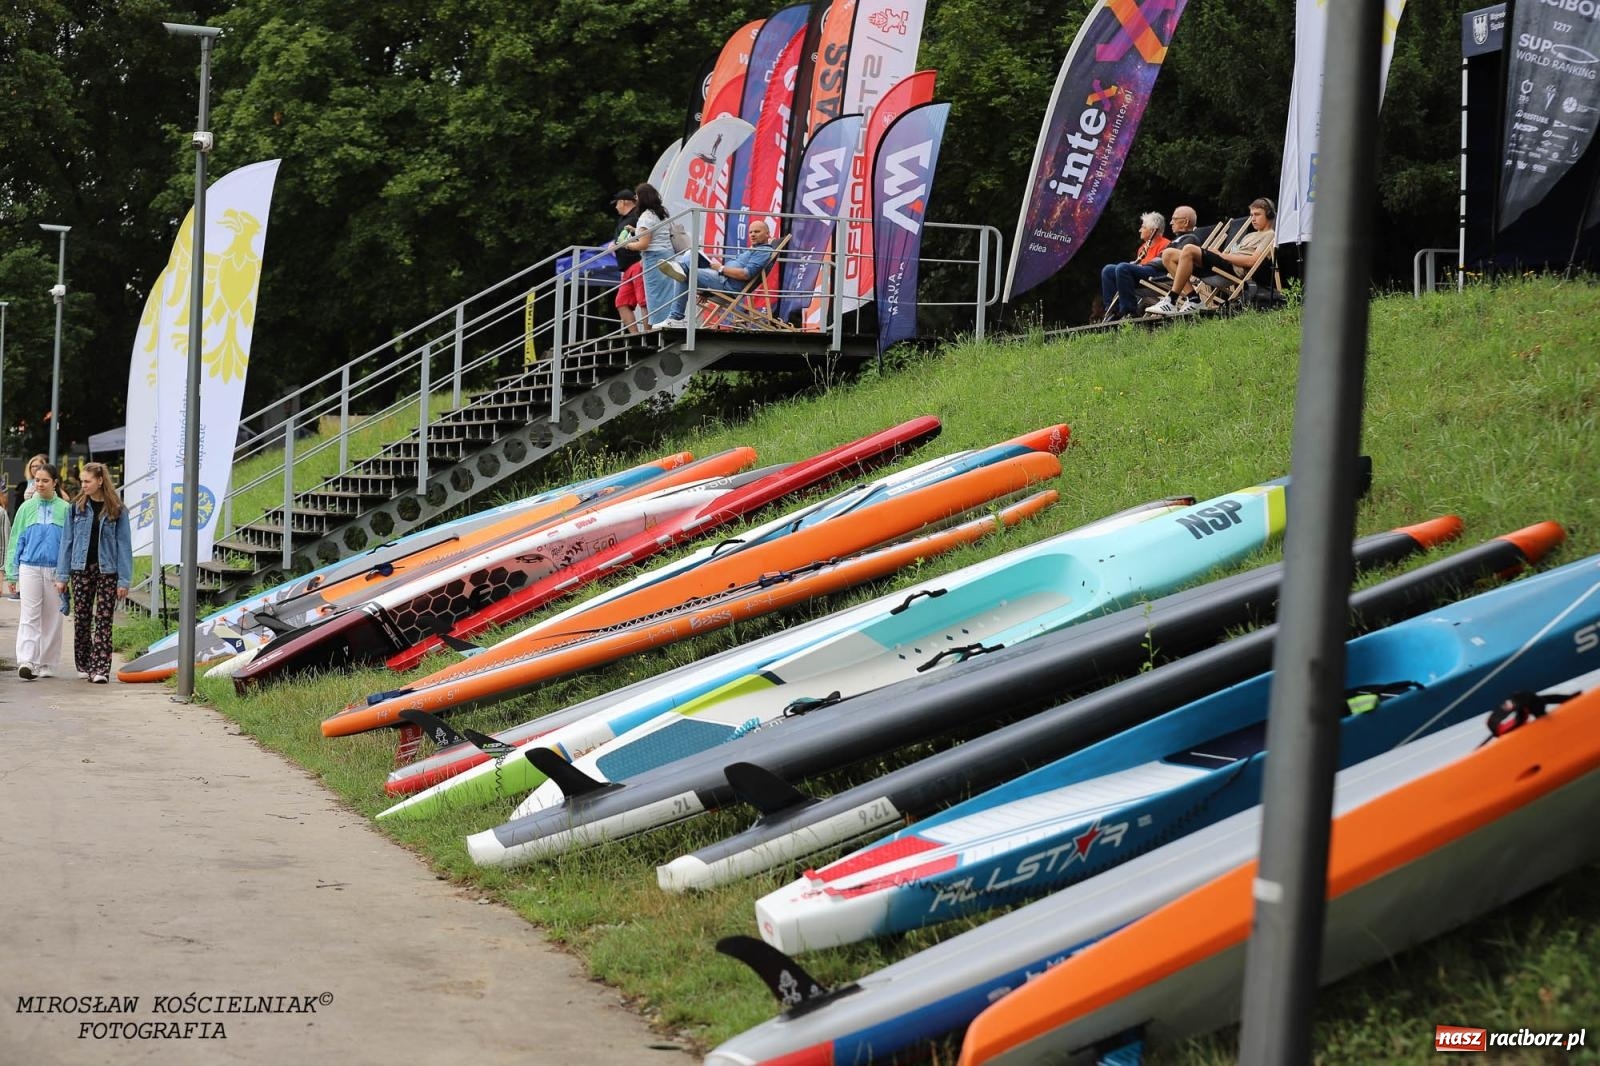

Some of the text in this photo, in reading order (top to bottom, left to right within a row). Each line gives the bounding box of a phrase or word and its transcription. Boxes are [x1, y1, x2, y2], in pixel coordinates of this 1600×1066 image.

[1518, 33, 1553, 52] SUP
[1516, 49, 1596, 79] WORLD RANKING
[1087, 90, 1133, 204] www.drukarniaintex.pl
[1175, 500, 1242, 539] NSP
